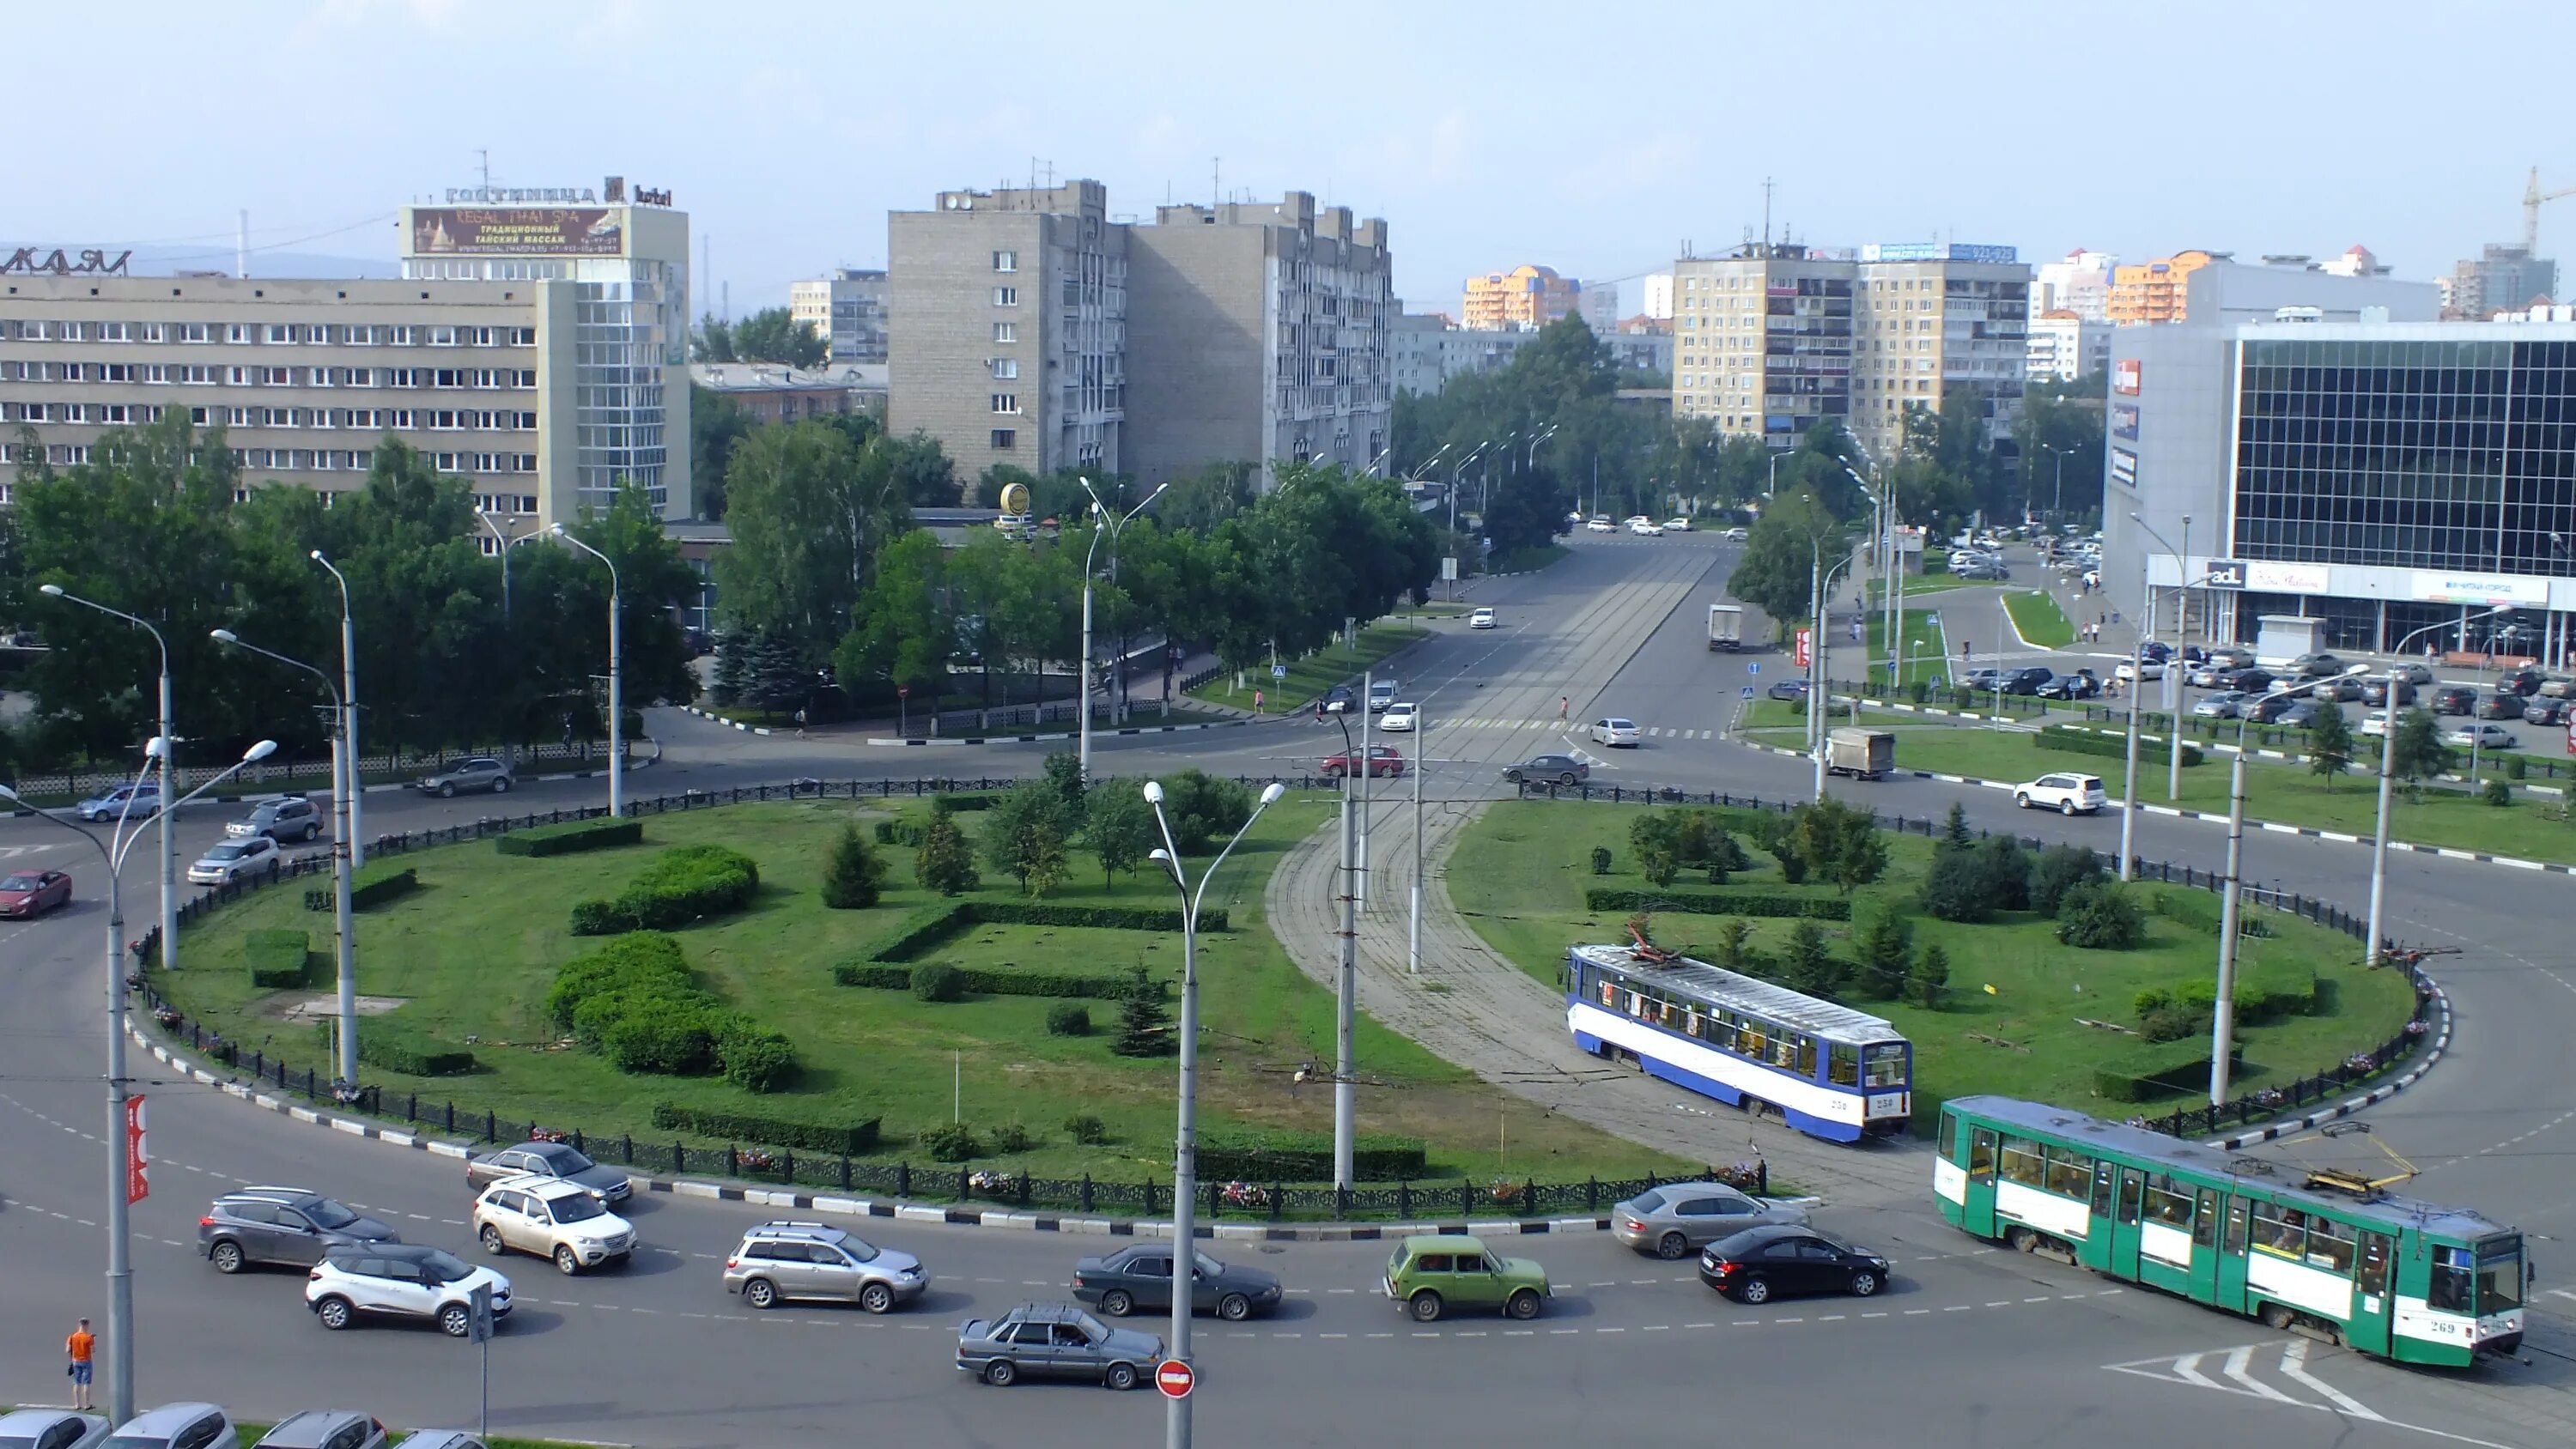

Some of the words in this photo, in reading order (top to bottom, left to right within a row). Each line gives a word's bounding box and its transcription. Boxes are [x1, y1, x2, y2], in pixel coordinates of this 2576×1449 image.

[446, 187, 597, 203] ГОСТИНИЦА
[456, 209, 501, 223] REGAL
[552, 209, 579, 223] SPA
[481, 223, 561, 233] ТРАДИЦИОННЫЙ
[475, 233, 519, 244] ТАЙСКИЙ
[524, 234, 566, 244] МАССАЖ
[2431, 1320, 2456, 1334] 269
